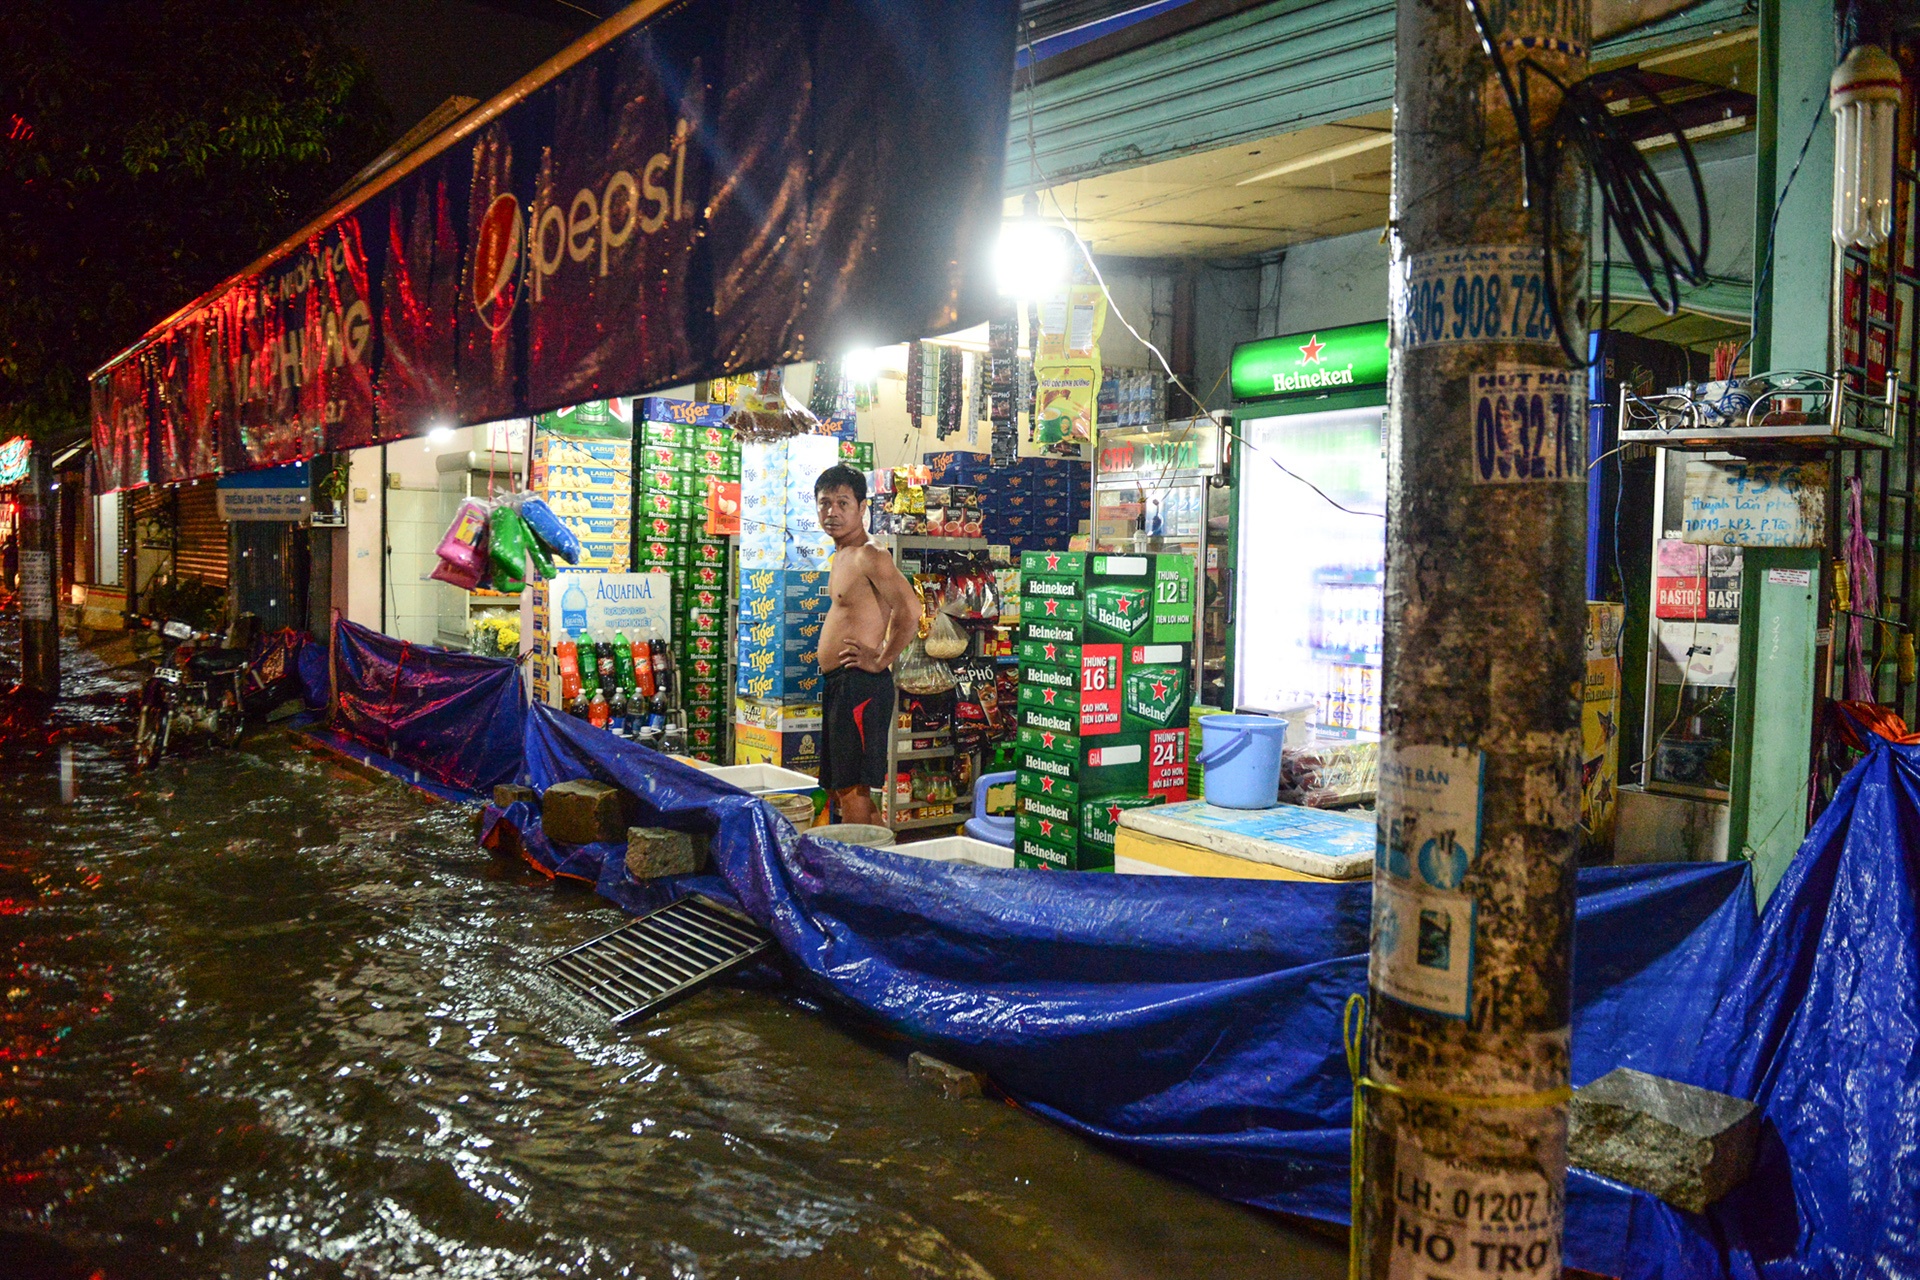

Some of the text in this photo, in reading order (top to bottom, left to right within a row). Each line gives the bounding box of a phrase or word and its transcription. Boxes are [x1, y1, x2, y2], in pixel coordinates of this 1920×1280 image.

[530, 118, 689, 302] pepsi
[1272, 364, 1353, 392] Heineken
[670, 401, 710, 424] Tiger
[932, 452, 954, 471] Tiger
[1100, 440, 1135, 472] CHÈ
[1177, 434, 1199, 468] MÁ
[796, 546, 814, 558] Tiger
[750, 569, 774, 594] Tiger
[800, 571, 820, 584] Tiger
[1030, 580, 1074, 596] Heineken
[596, 577, 652, 602] AQUAFINA
[1157, 582, 1178, 603] 12
[1660, 589, 1701, 606] BASTOS
[1708, 590, 1740, 608] BAST
[750, 596, 776, 620] Tiger
[800, 598, 819, 610] Tiger
[799, 624, 819, 637] Tiger
[1098, 608, 1132, 632] Heine
[750, 622, 776, 646] Tiger
[1028, 625, 1073, 642] Heineken
[749, 648, 774, 672] Tiger
[968, 664, 994, 681] PHỐ
[1028, 668, 1072, 686] Heineken
[1083, 668, 1105, 690] 16
[748, 675, 774, 699] Tiger
[1082, 704, 1094, 712] CAO
[1026, 712, 1072, 732] Heineken
[1026, 755, 1070, 776] Heineken
[1153, 744, 1174, 766] 24
[1024, 798, 1069, 820] Heineken
[1024, 841, 1068, 865] Heineken
[1397, 1172, 1442, 1215] LH:
